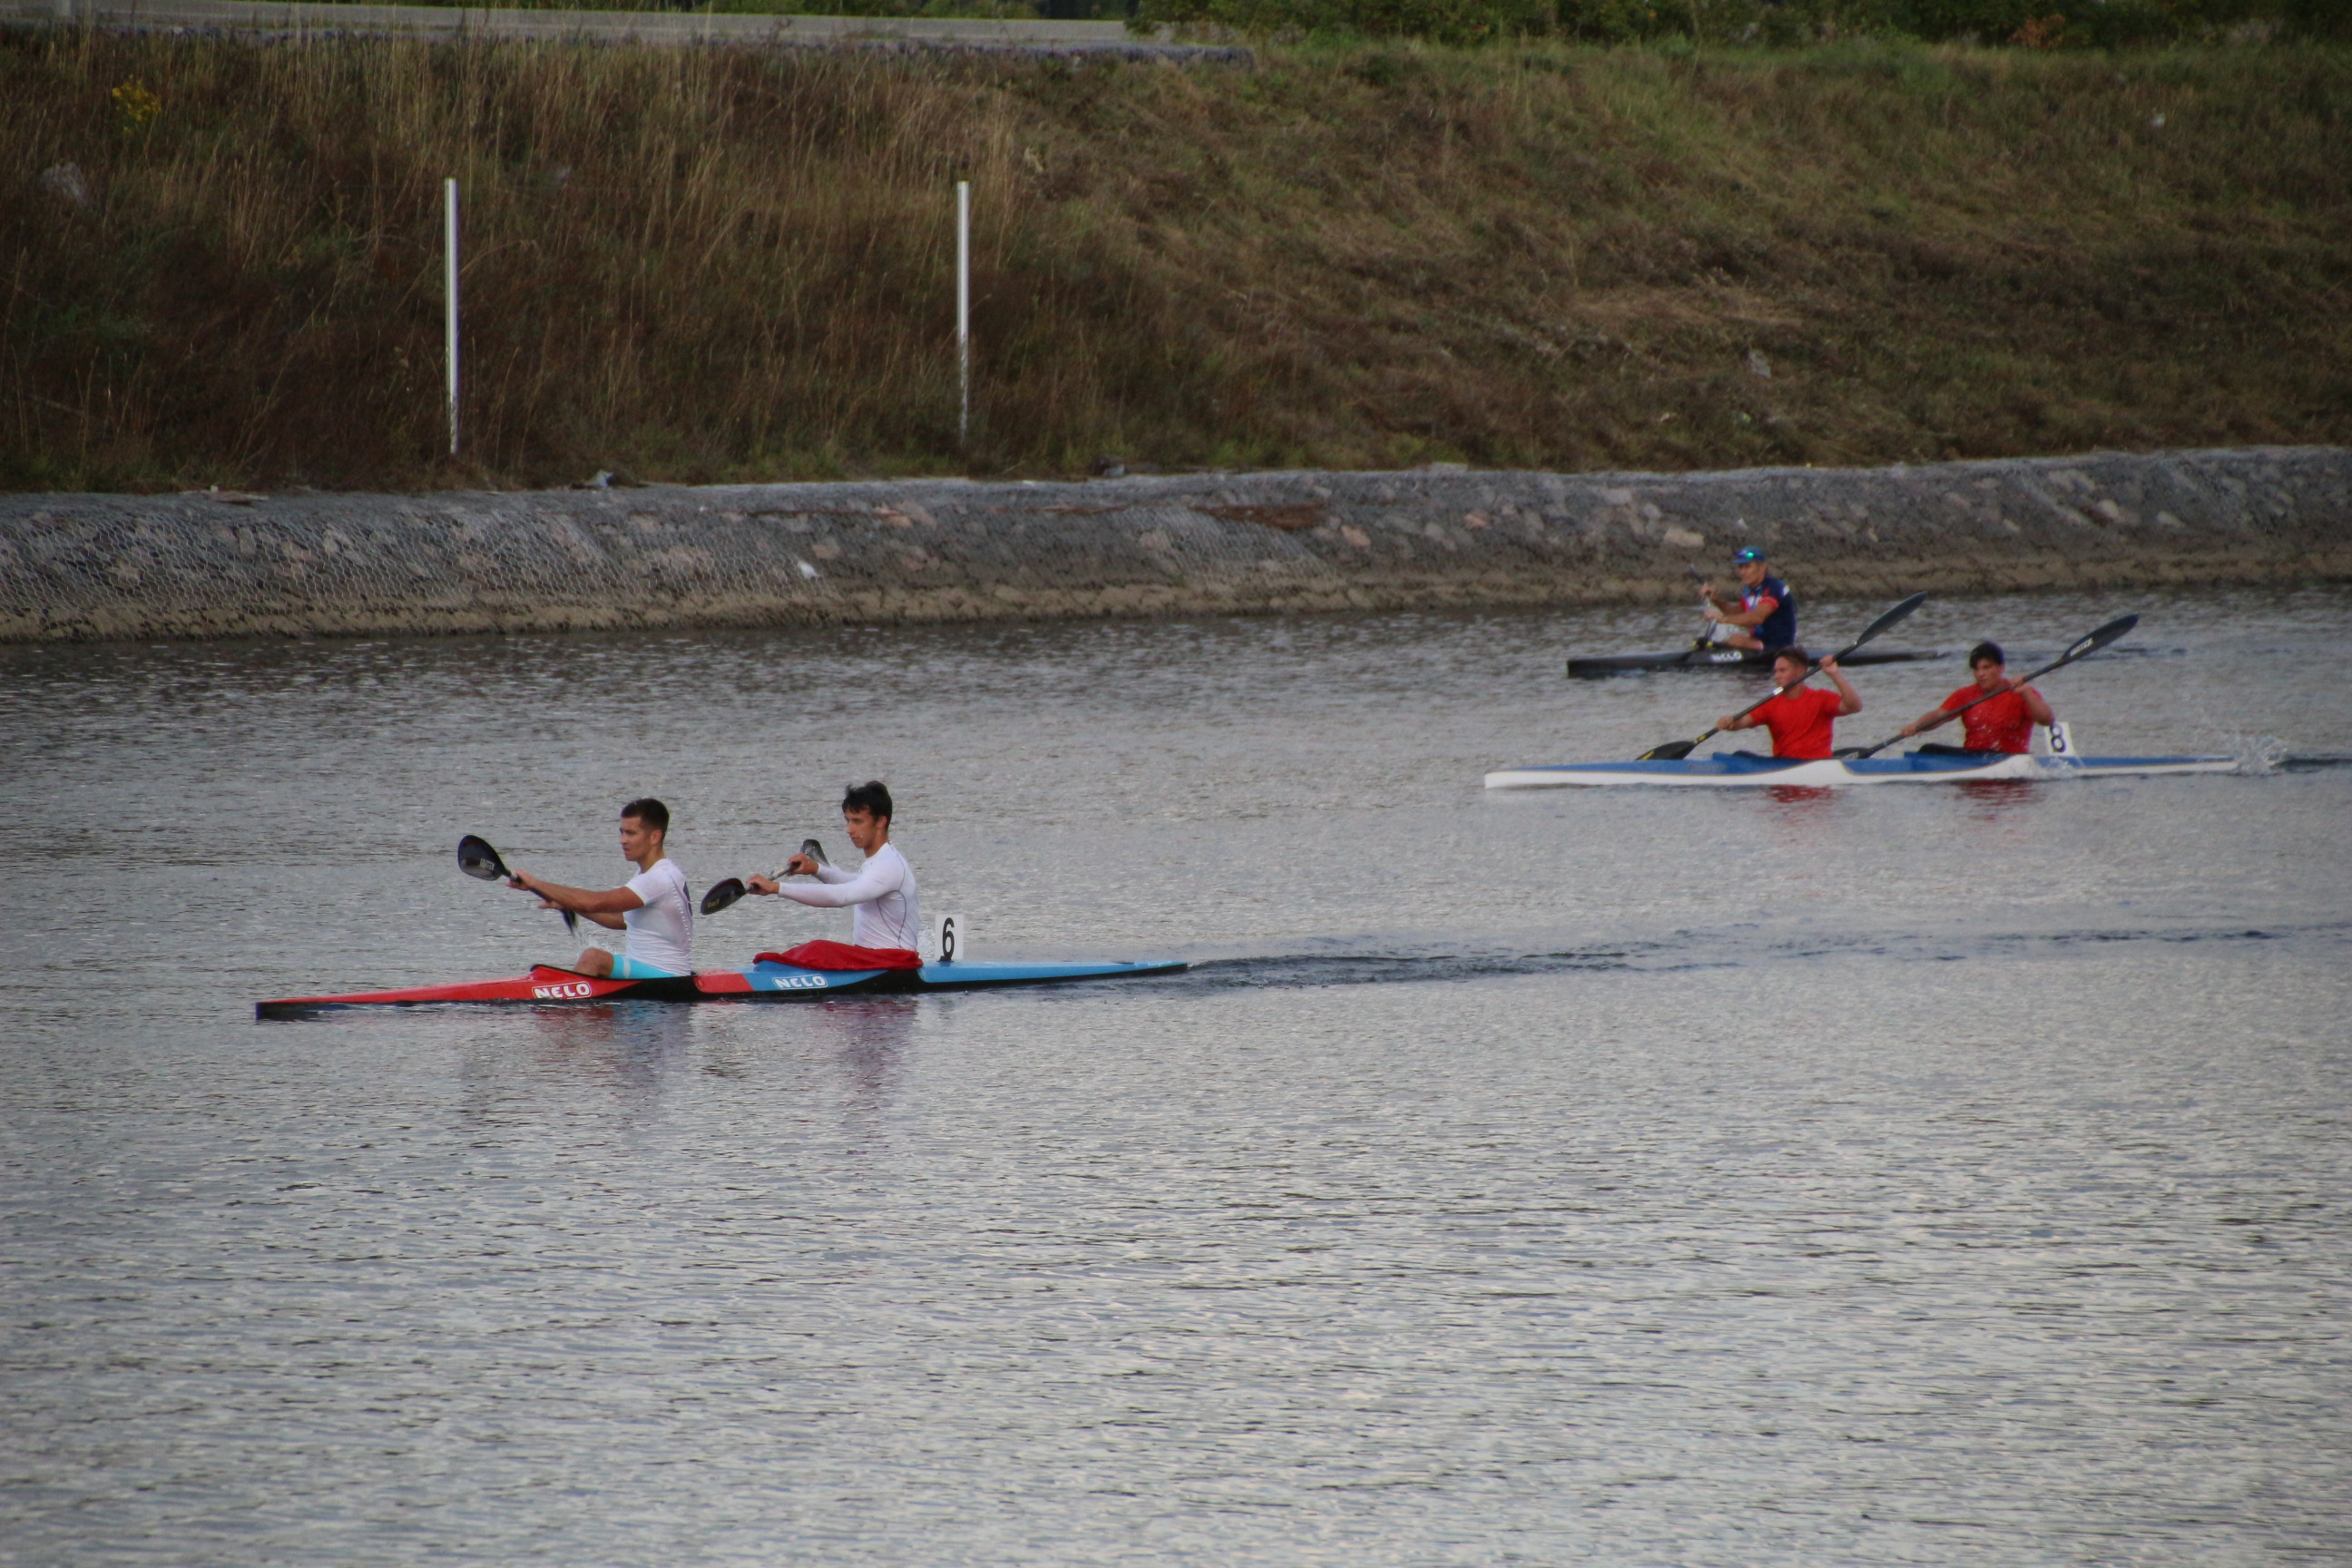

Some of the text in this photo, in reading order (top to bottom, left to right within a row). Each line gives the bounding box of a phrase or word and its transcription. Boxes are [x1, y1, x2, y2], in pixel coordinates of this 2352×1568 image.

[2050, 724, 2066, 752] 8
[943, 917, 955, 958] 6
[534, 984, 590, 998] NELO
[775, 976, 827, 988] NELO
